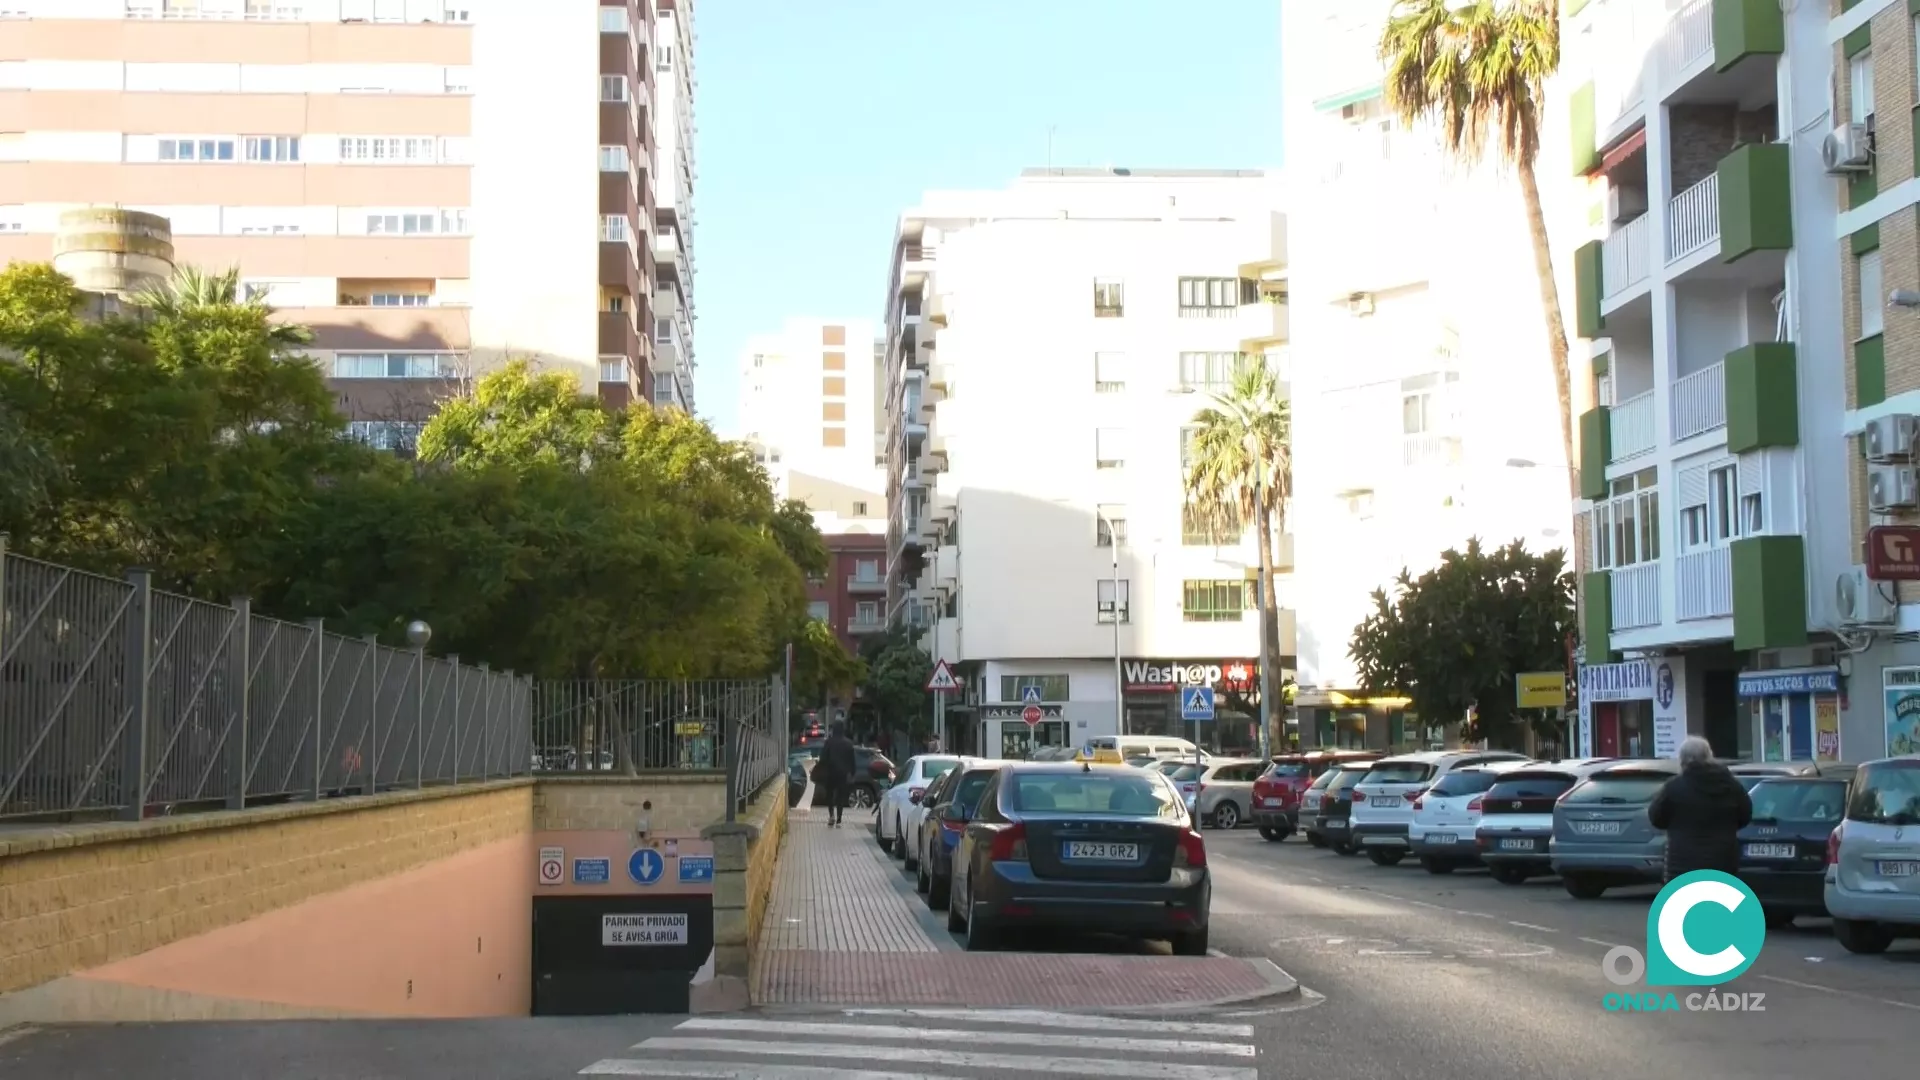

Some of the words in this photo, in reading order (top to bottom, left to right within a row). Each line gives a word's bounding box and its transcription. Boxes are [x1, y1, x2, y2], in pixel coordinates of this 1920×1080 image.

[1124, 661, 1222, 688] Wash@p
[1024, 711, 1040, 719] STOP
[1073, 843, 1105, 857] 2423
[605, 916, 644, 927] PARKING
[646, 916, 685, 927] PRIVADO
[612, 931, 623, 942] SE
[626, 931, 652, 942] AVISA
[654, 929, 679, 942] GRÚA
